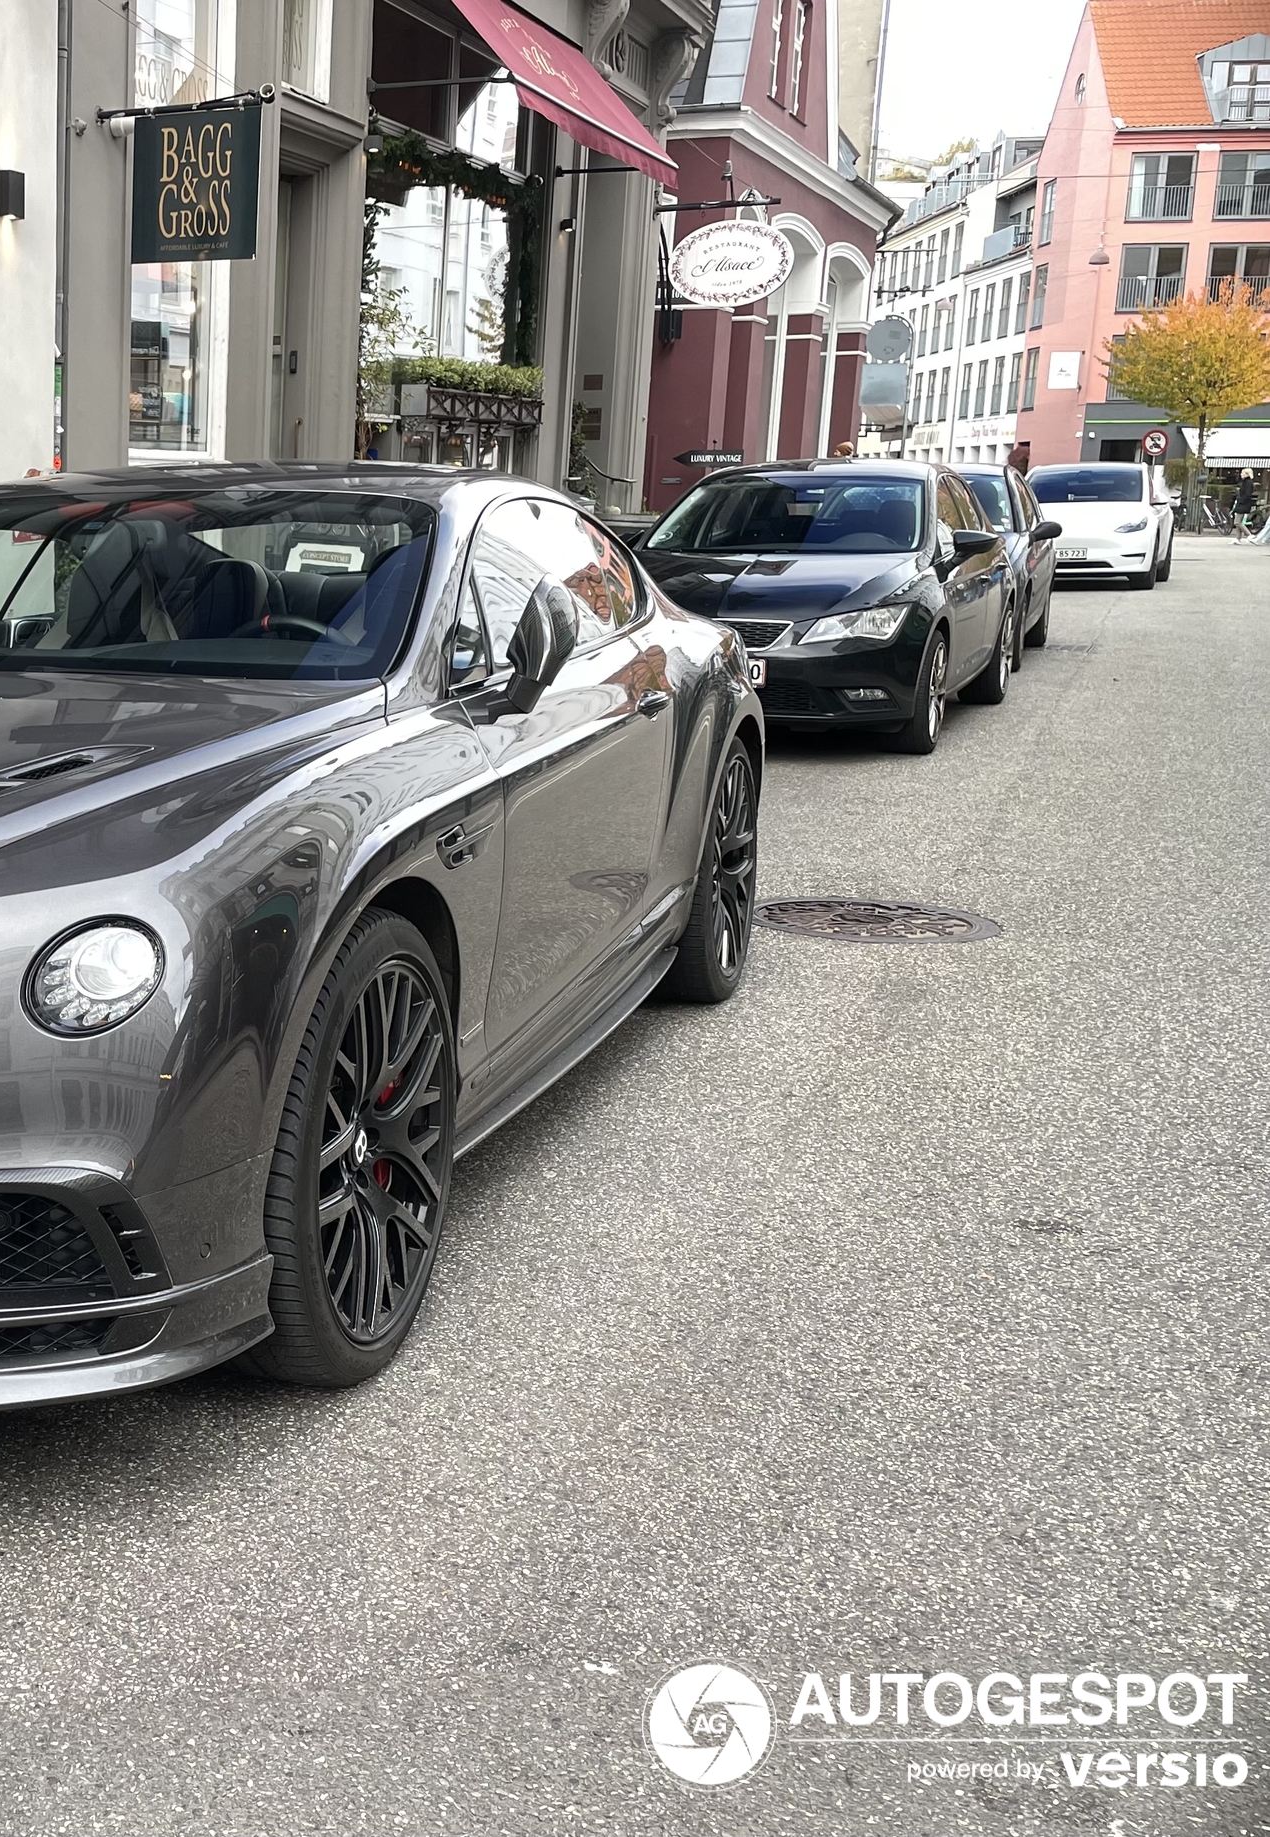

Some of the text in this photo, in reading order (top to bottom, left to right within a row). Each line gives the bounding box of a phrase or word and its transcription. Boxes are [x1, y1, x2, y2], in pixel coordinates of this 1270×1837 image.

[159, 122, 232, 182] BAGG
[181, 166, 198, 204] &
[158, 179, 231, 239] GROSS
[703, 241, 760, 255] RESTAURANT
[690, 454, 742, 463] LUXURY VINTAGE
[302, 552, 349, 562] CONCEPT STORE
